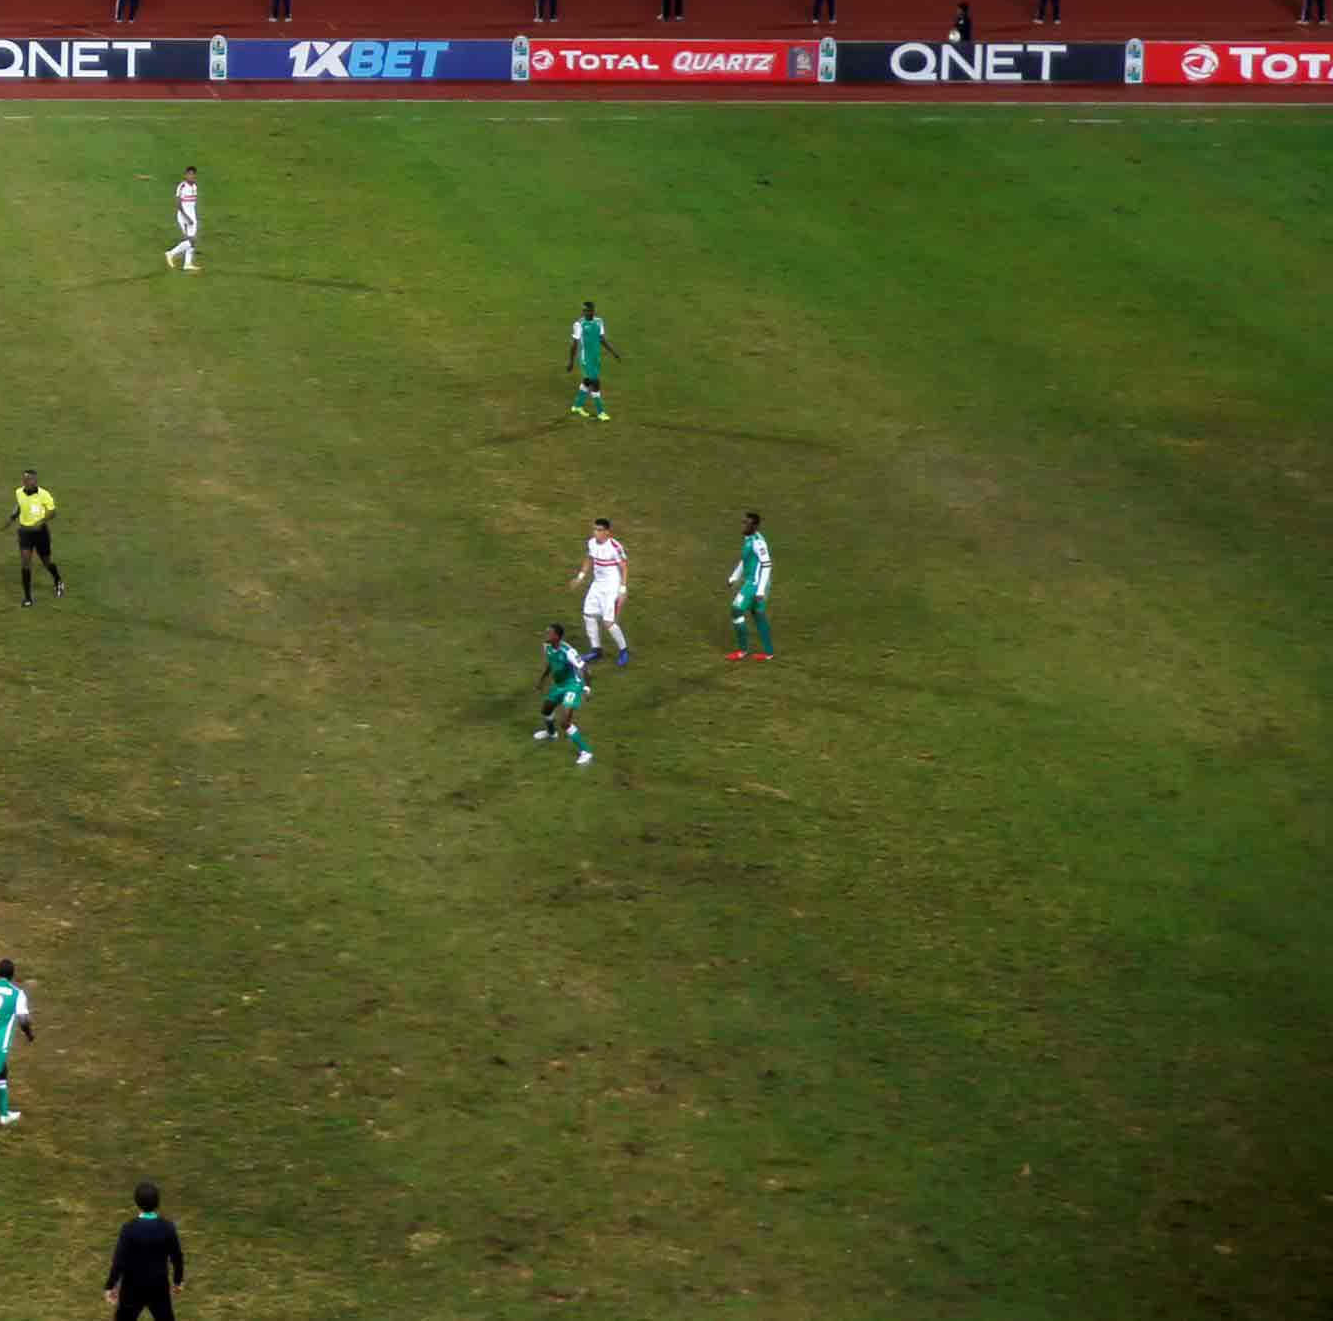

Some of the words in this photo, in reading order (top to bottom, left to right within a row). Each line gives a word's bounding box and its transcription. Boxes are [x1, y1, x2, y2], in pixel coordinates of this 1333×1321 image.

[289, 40, 450, 78] 1XBET
[559, 49, 660, 71] TOTAL
[672, 51, 777, 73] QUARTZ
[890, 42, 1067, 81] QNET
[1228, 46, 1333, 80] TOT
